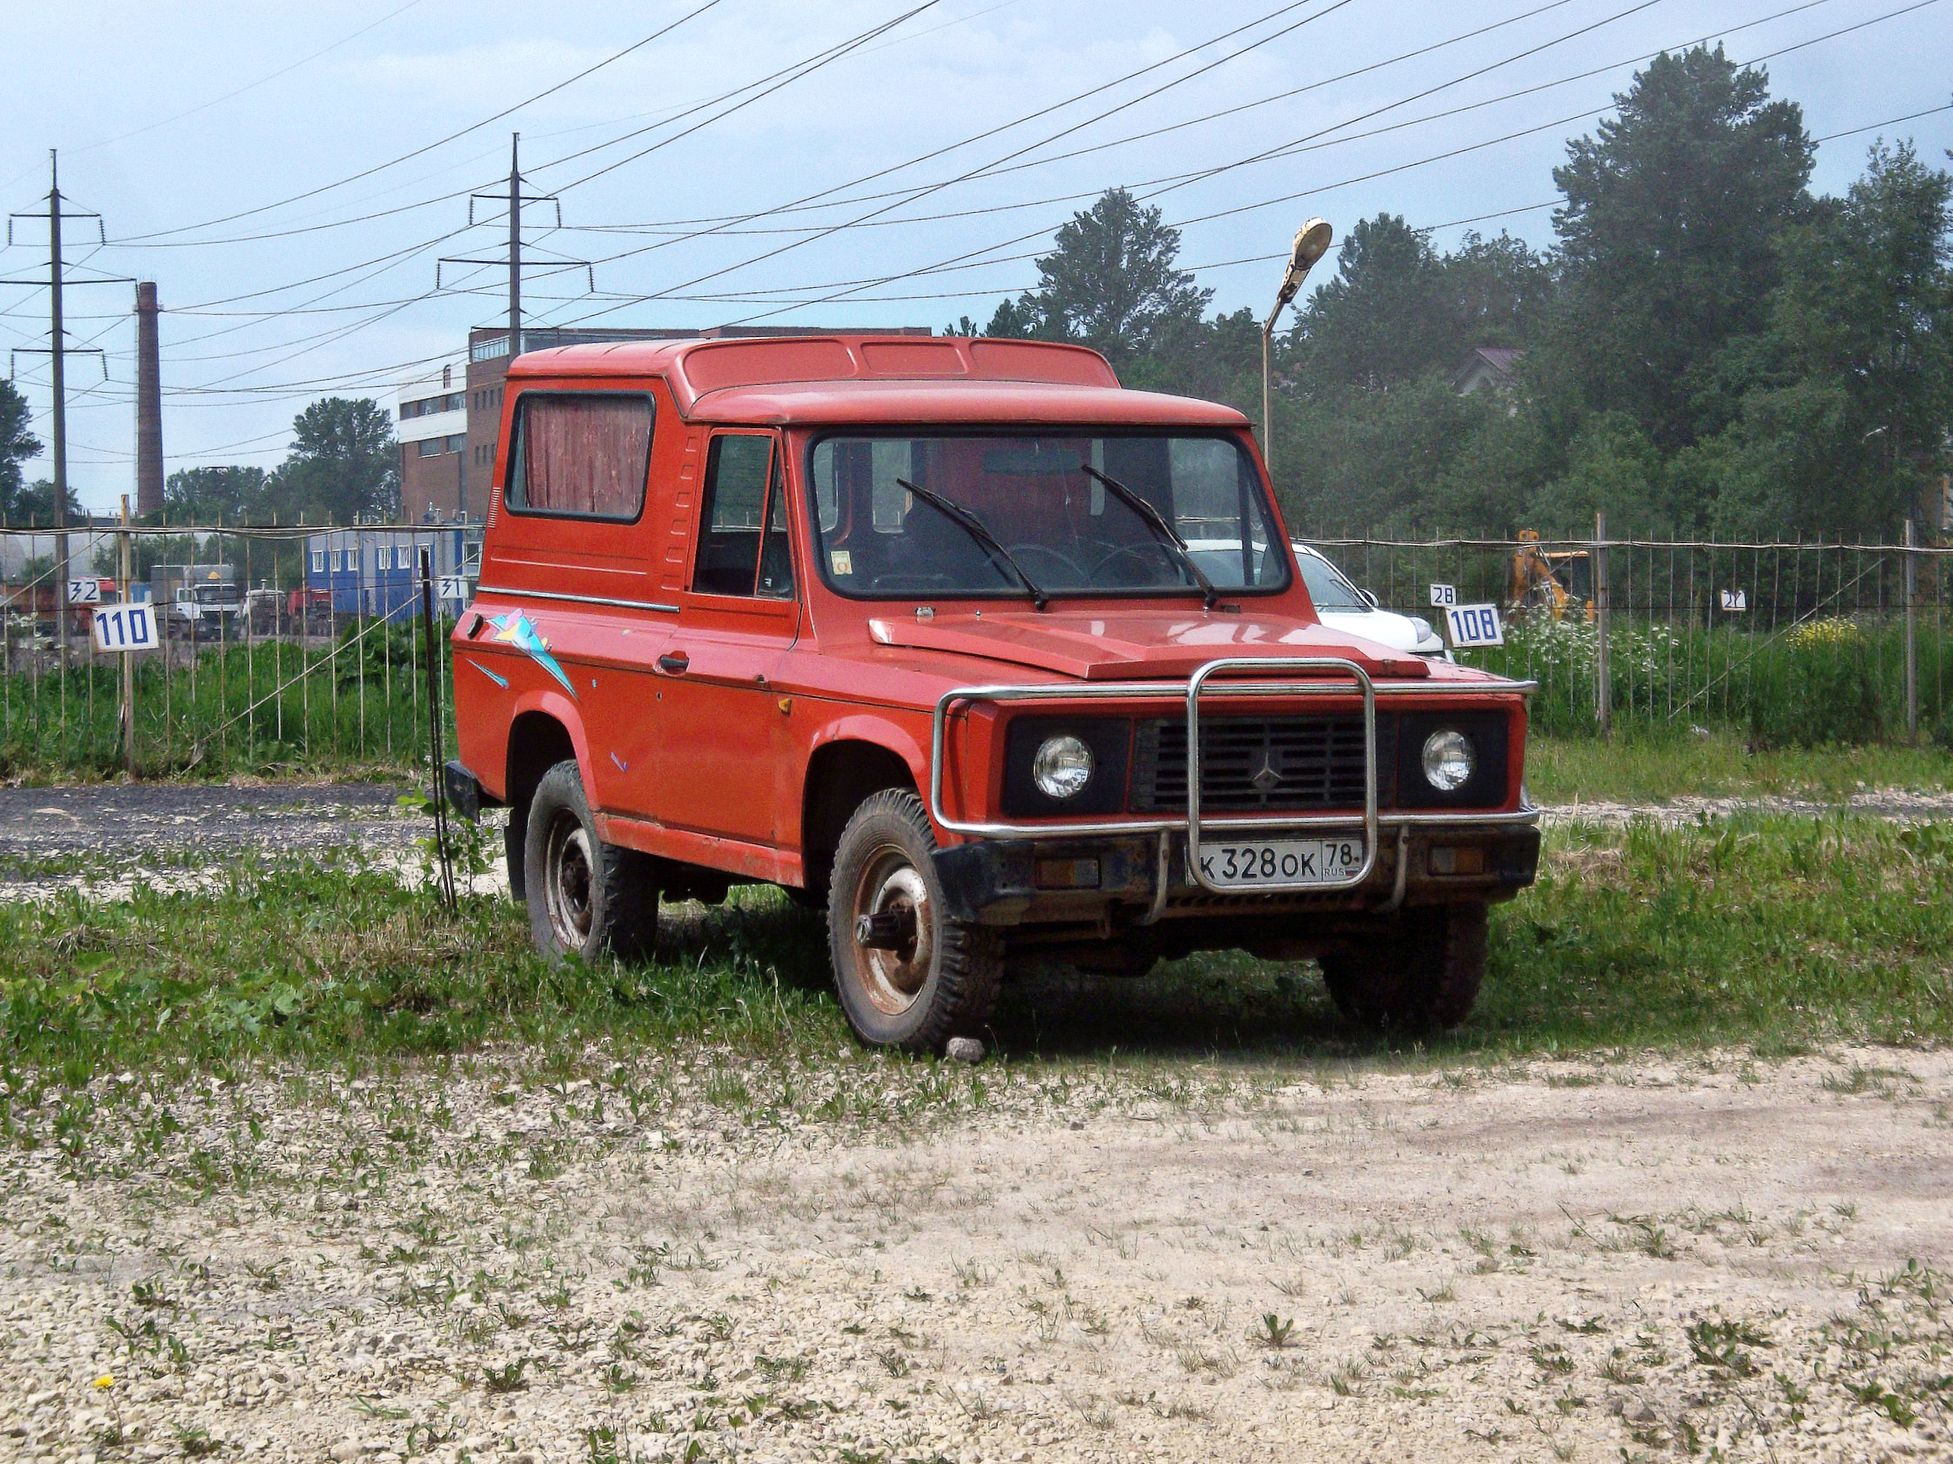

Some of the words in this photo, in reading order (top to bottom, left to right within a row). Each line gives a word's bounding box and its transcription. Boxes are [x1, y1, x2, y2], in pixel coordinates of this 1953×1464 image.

[70, 581, 97, 600] 32
[442, 578, 460, 596] 31
[1433, 587, 1453, 603] 28
[95, 609, 149, 645] 110
[1451, 609, 1497, 642] 108
[1325, 843, 1352, 867] 78
[1324, 867, 1345, 877] RUS
